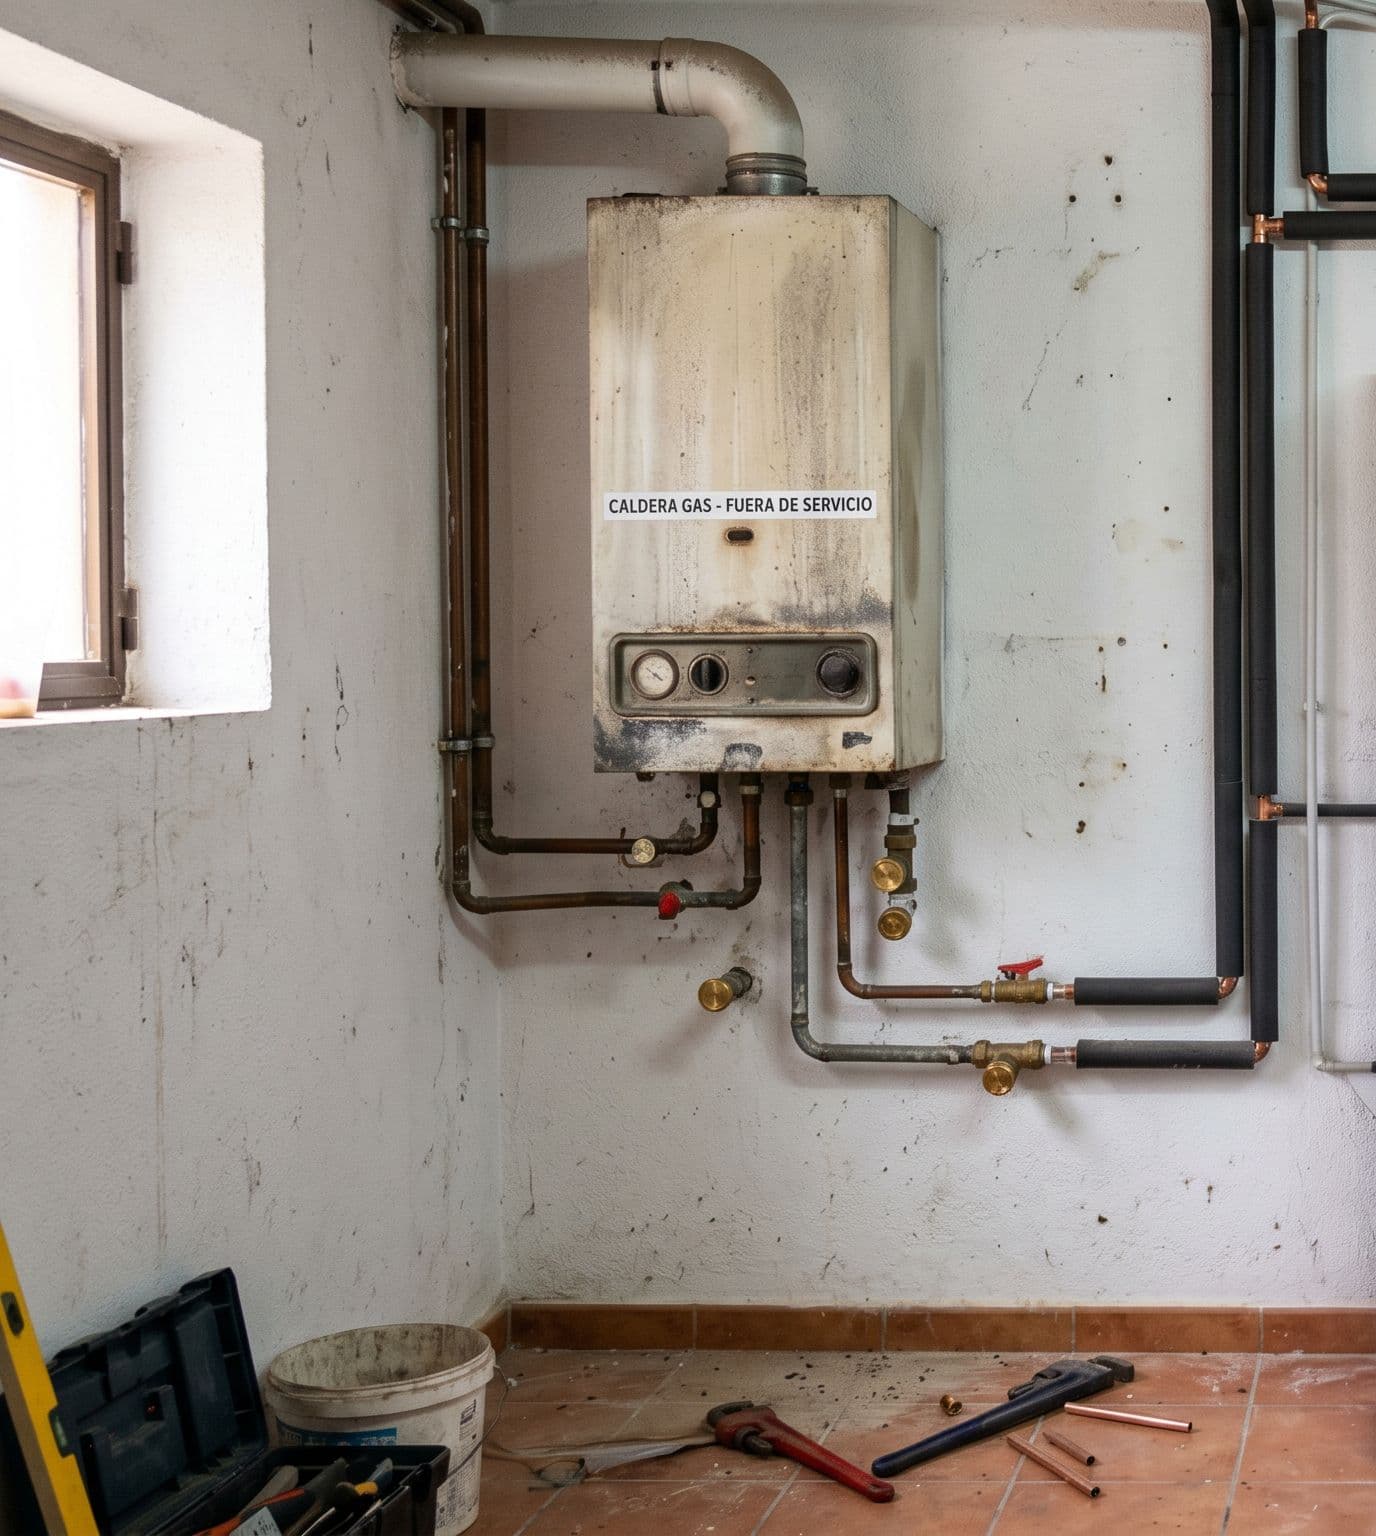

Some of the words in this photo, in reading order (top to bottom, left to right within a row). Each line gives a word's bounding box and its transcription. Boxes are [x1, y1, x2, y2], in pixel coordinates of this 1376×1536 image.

[608, 498, 678, 514] CALDERA
[681, 498, 712, 513] GAS
[726, 497, 775, 512] FUERA
[779, 497, 799, 512] DE
[803, 496, 873, 512] SERVICIO
